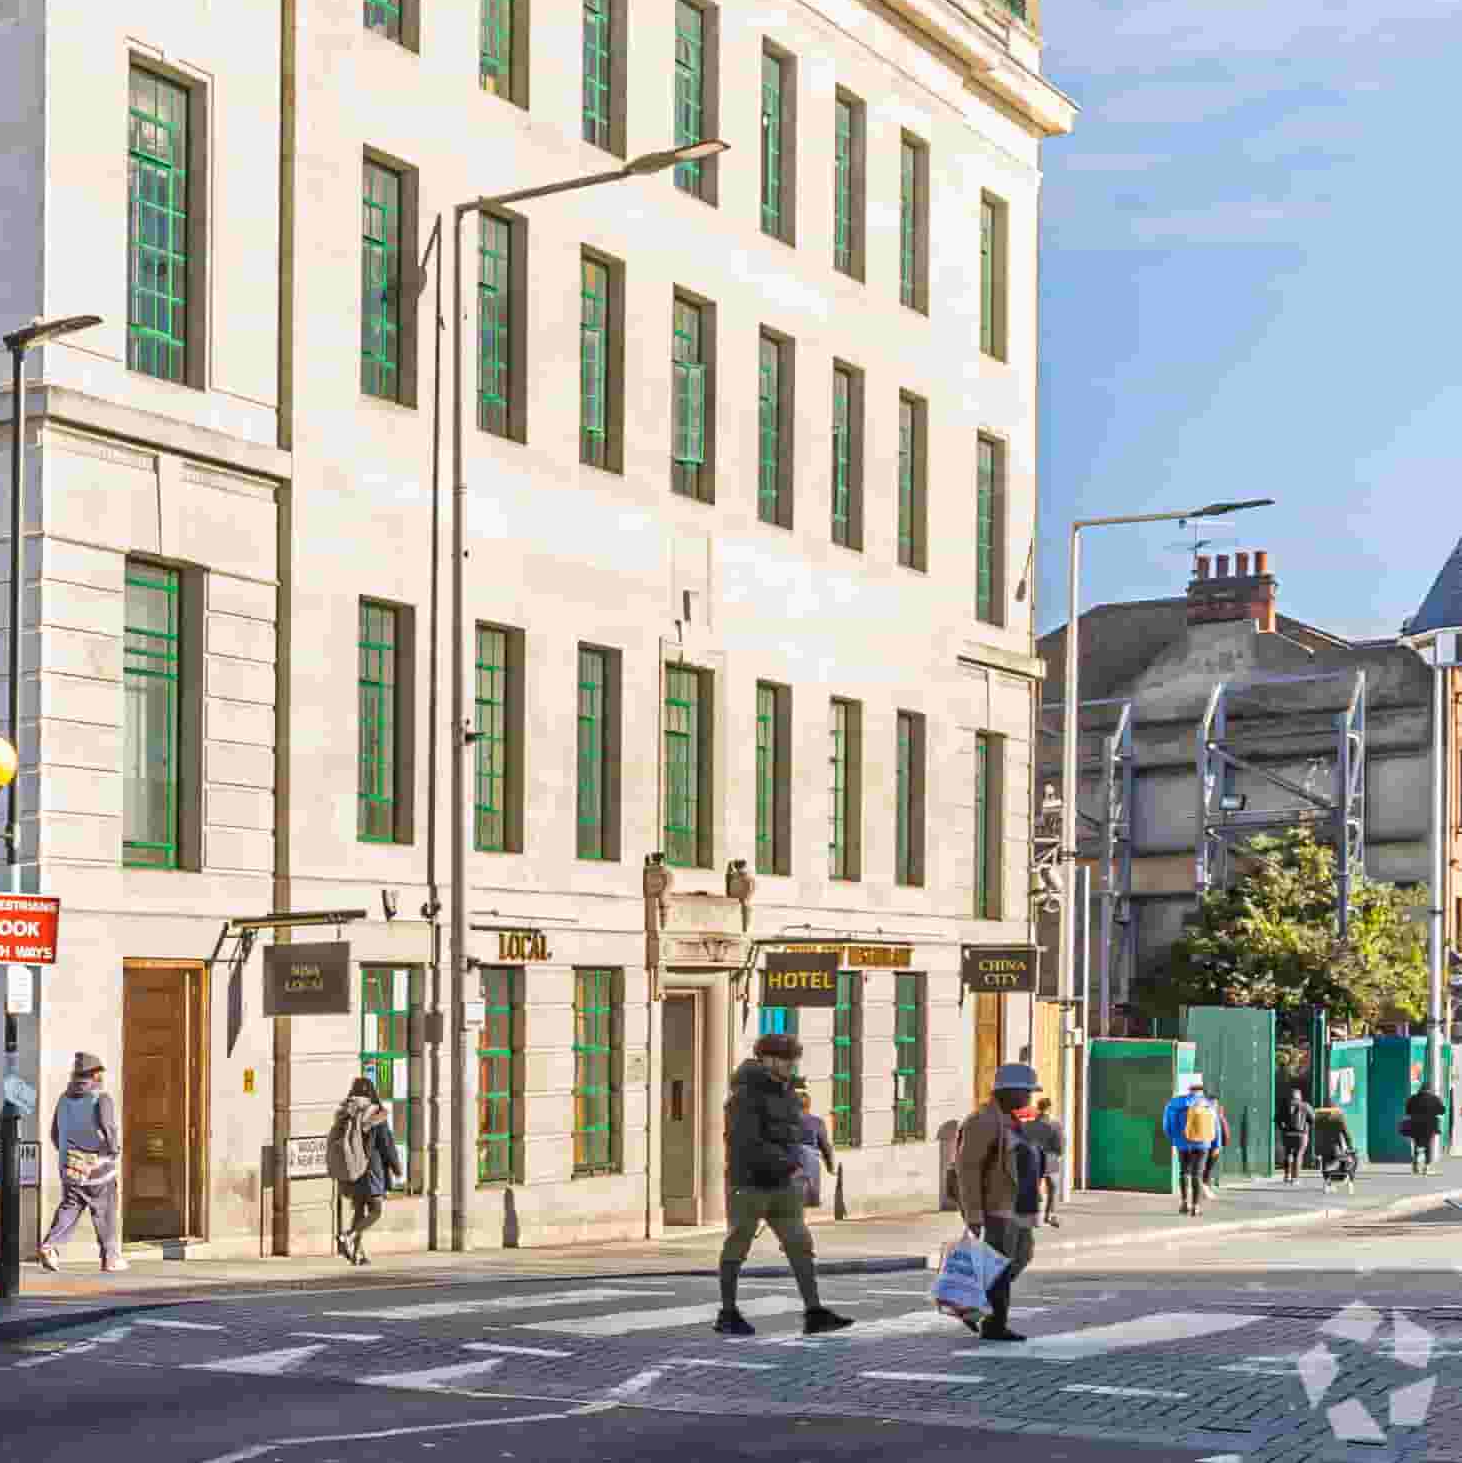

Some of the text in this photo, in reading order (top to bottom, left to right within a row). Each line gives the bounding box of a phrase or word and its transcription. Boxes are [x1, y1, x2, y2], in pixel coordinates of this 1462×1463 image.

[15, 945, 52, 960] WAYS
[499, 932, 552, 962] LOCAL
[978, 960, 1028, 973] CHINA
[768, 970, 836, 990] HOTEL
[983, 973, 1021, 988] CITY
